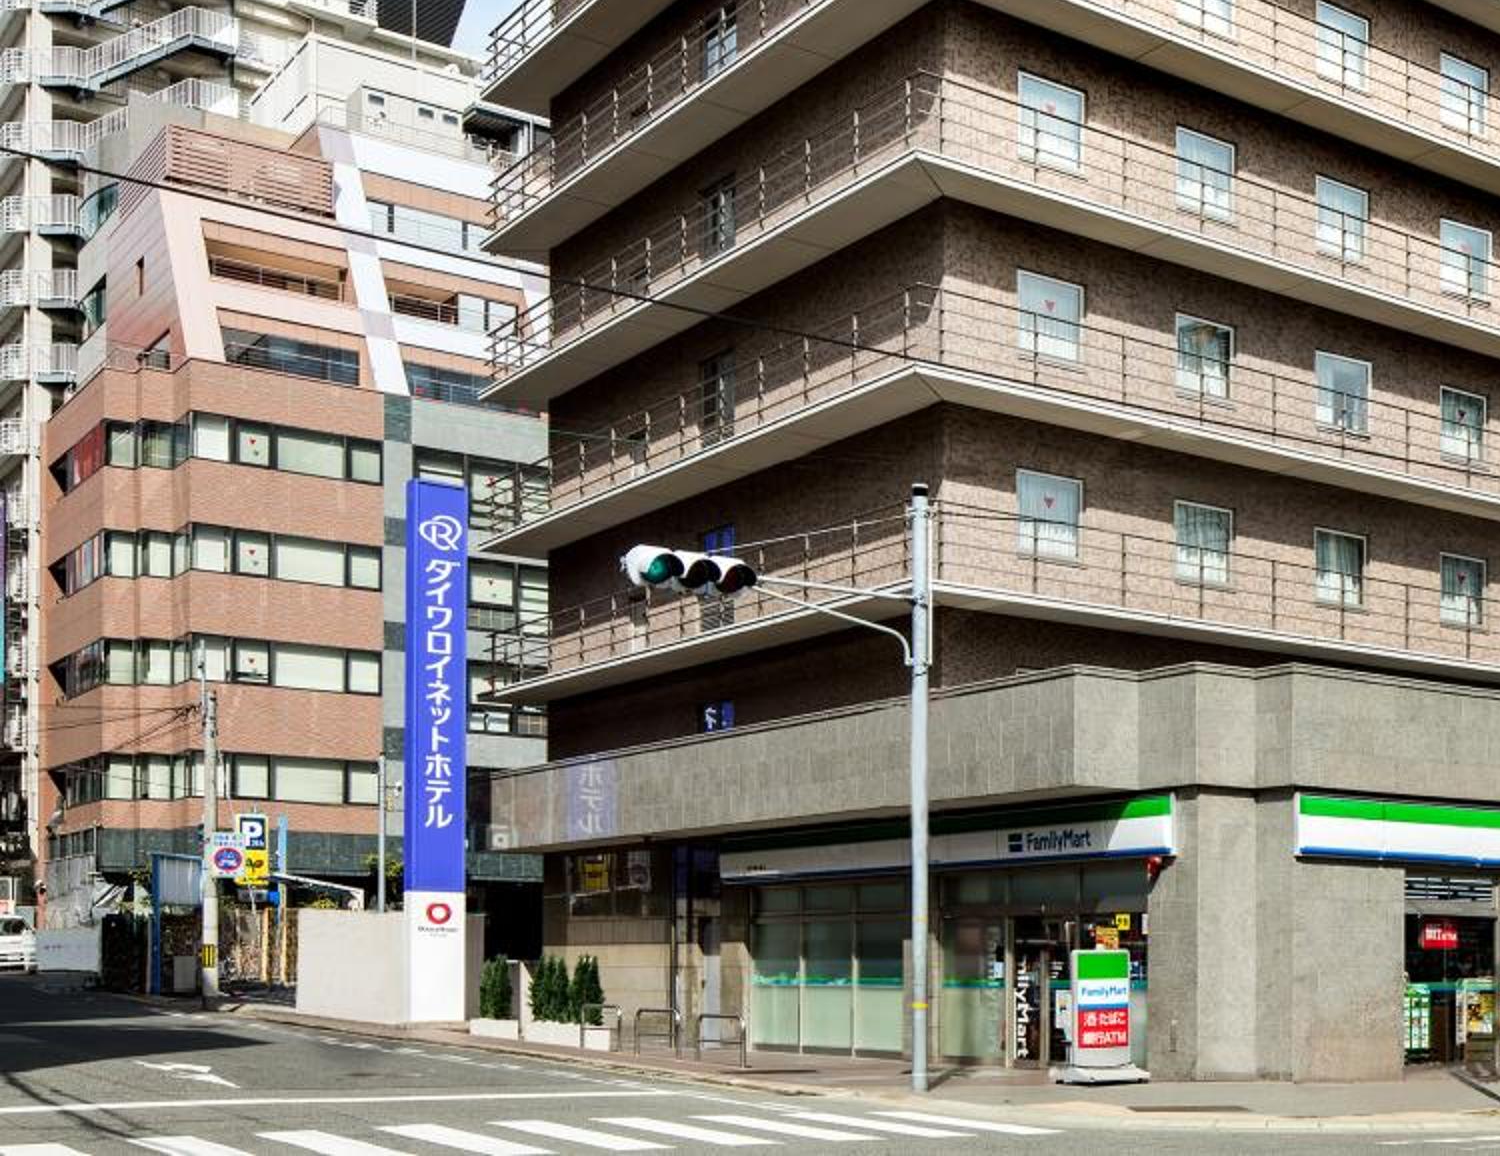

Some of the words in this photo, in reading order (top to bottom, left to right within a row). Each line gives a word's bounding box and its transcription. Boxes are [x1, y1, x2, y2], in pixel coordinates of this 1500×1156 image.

[424, 559, 461, 828] ダイワロイネットホテル
[242, 821, 263, 846] P
[1026, 830, 1091, 853] FamilyMart
